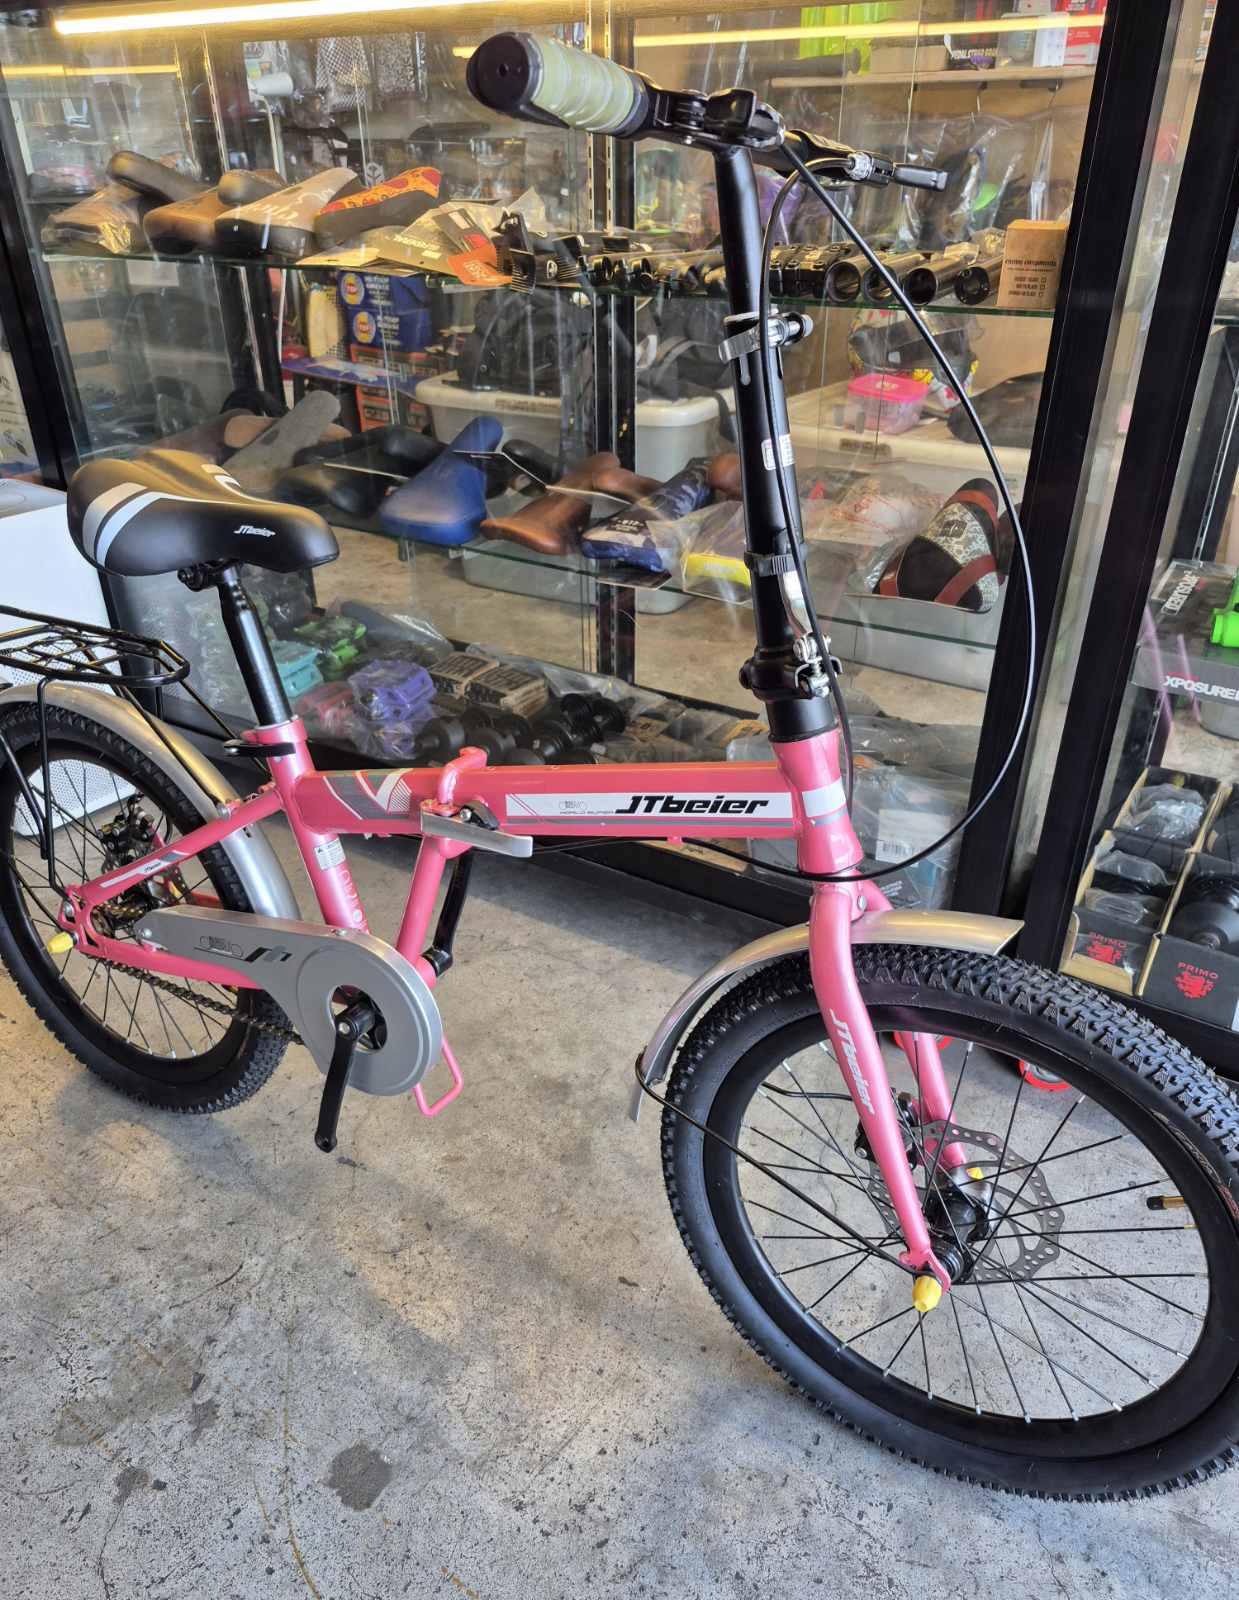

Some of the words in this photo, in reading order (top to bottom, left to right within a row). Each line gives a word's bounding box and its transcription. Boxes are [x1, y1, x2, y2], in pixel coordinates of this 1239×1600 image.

[1163, 675, 1239, 701] XPOSURE
[615, 795, 769, 815] JTbeier
[1088, 931, 1129, 949] PRIMO
[1177, 961, 1220, 980] PRIMO
[829, 1007, 876, 1115] JTbeier
